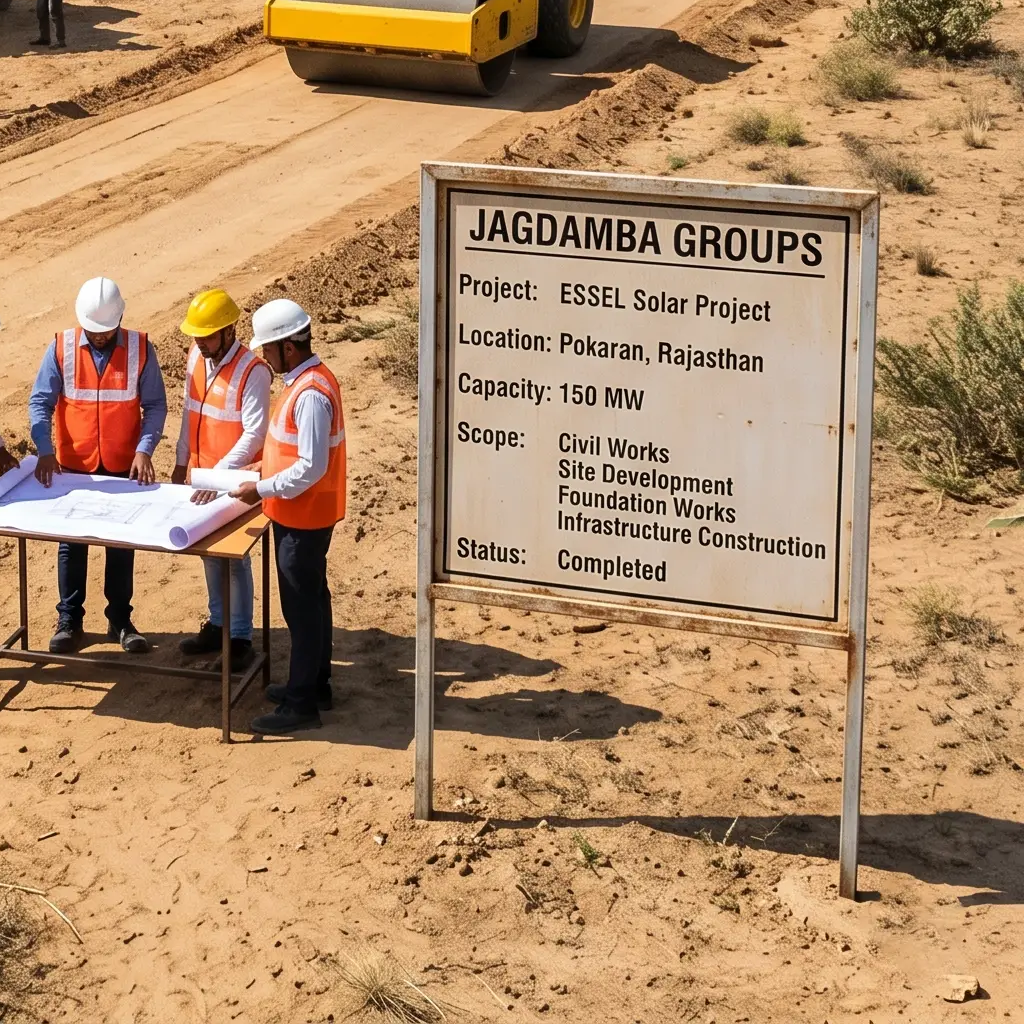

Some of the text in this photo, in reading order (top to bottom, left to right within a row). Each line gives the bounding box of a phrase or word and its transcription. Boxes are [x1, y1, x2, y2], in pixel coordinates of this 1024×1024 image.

[469, 208, 823, 267] JAGDAMBA GROUPS
[459, 273, 771, 325] Project: ESSEL Solar Project
[459, 322, 764, 373] Location: Pokaran, Rajasthan
[458, 372, 645, 411] Capacity: 150 MW
[457, 421, 670, 464] Scope: Civil Works
[558, 458, 734, 497] Site Development
[558, 484, 736, 524] Foundation Works
[558, 510, 826, 560] Infrastructure Construction
[456, 536, 667, 583] Status: Completed
